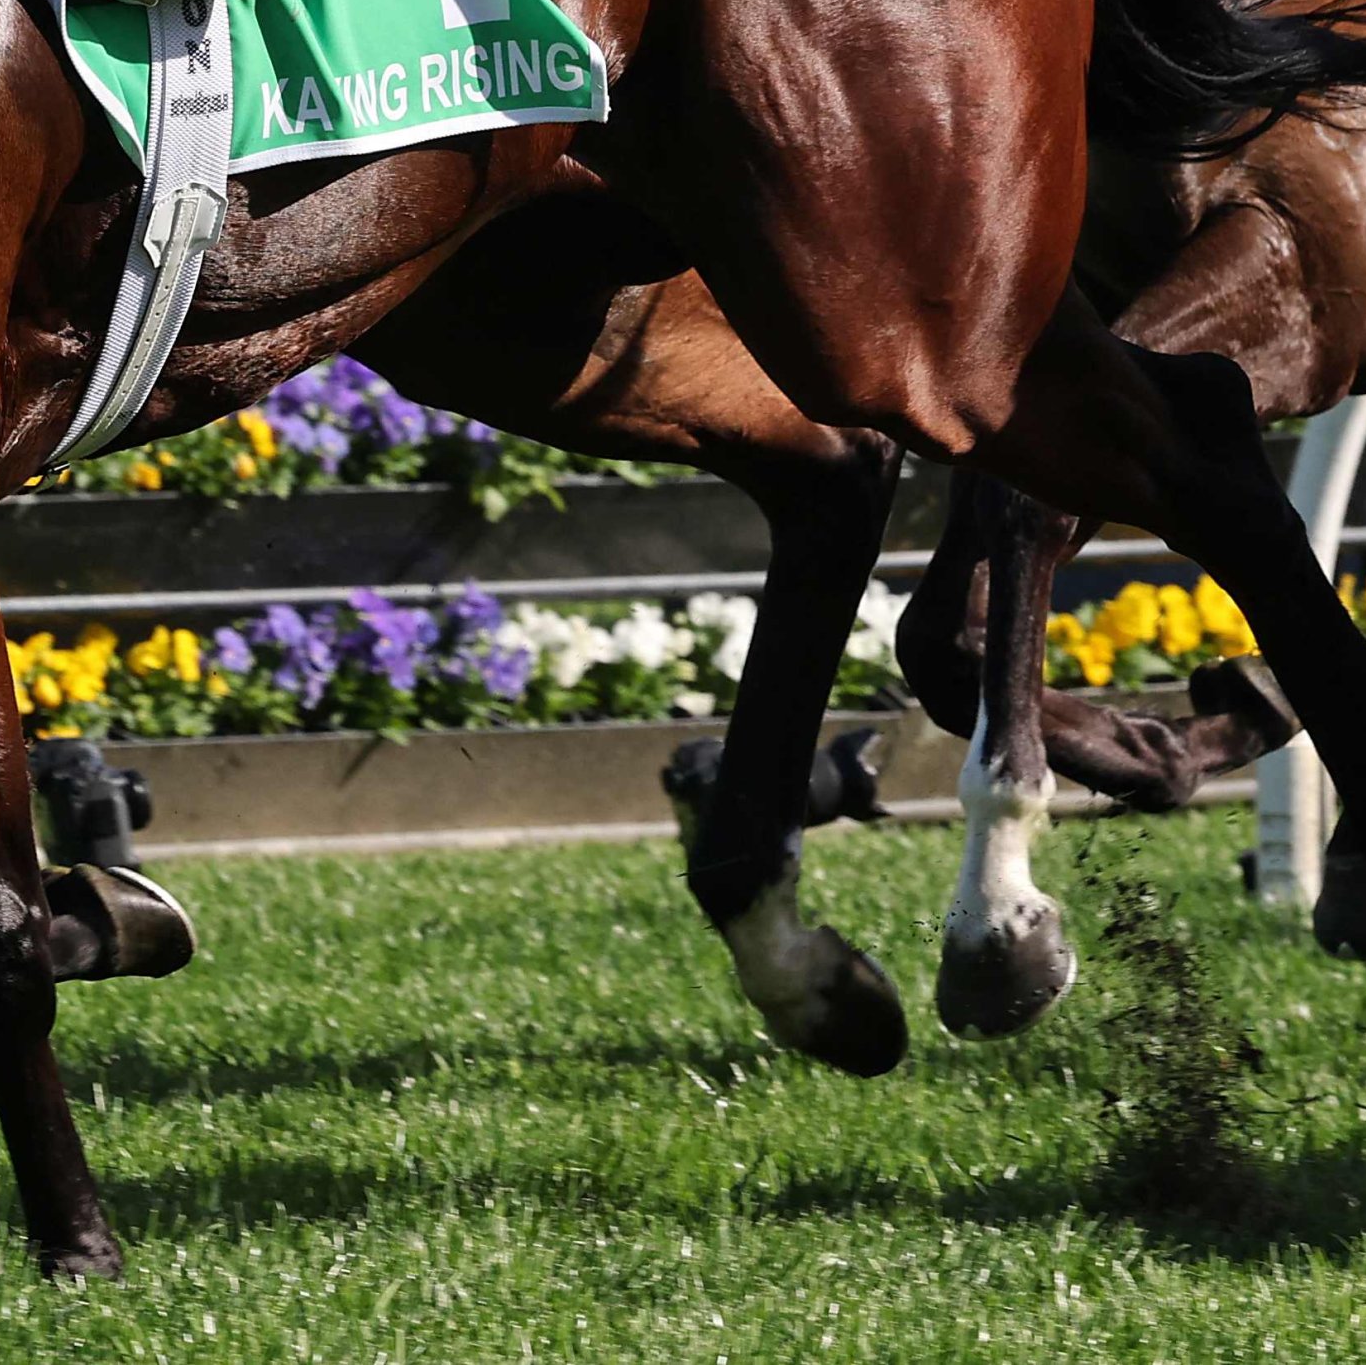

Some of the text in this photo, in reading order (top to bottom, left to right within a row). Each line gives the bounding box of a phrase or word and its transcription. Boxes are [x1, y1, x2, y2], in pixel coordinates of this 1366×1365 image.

[261, 77, 333, 139] KA
[334, 63, 408, 129] ING
[420, 39, 584, 113] RISING
